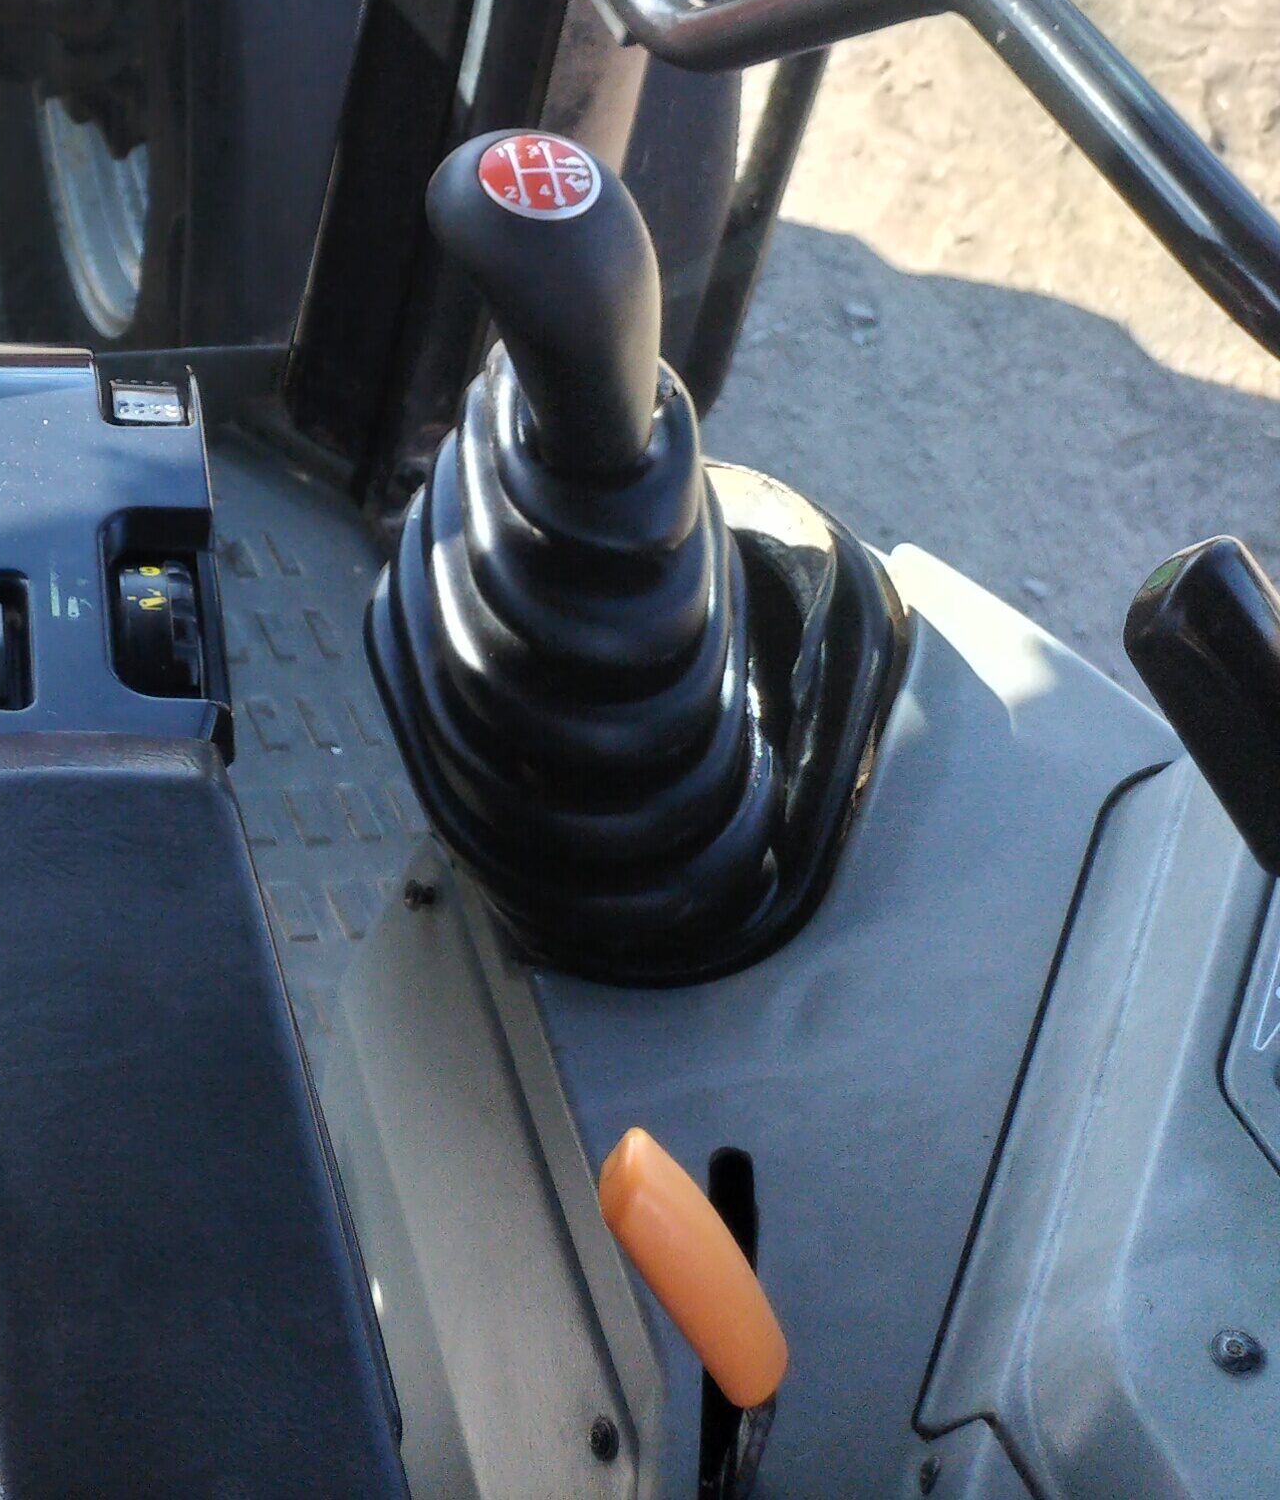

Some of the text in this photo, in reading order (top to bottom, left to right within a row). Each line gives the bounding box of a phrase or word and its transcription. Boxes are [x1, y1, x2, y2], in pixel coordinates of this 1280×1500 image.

[495, 147, 506, 158] 1
[504, 184, 520, 200] 2
[538, 183, 552, 197] 4
